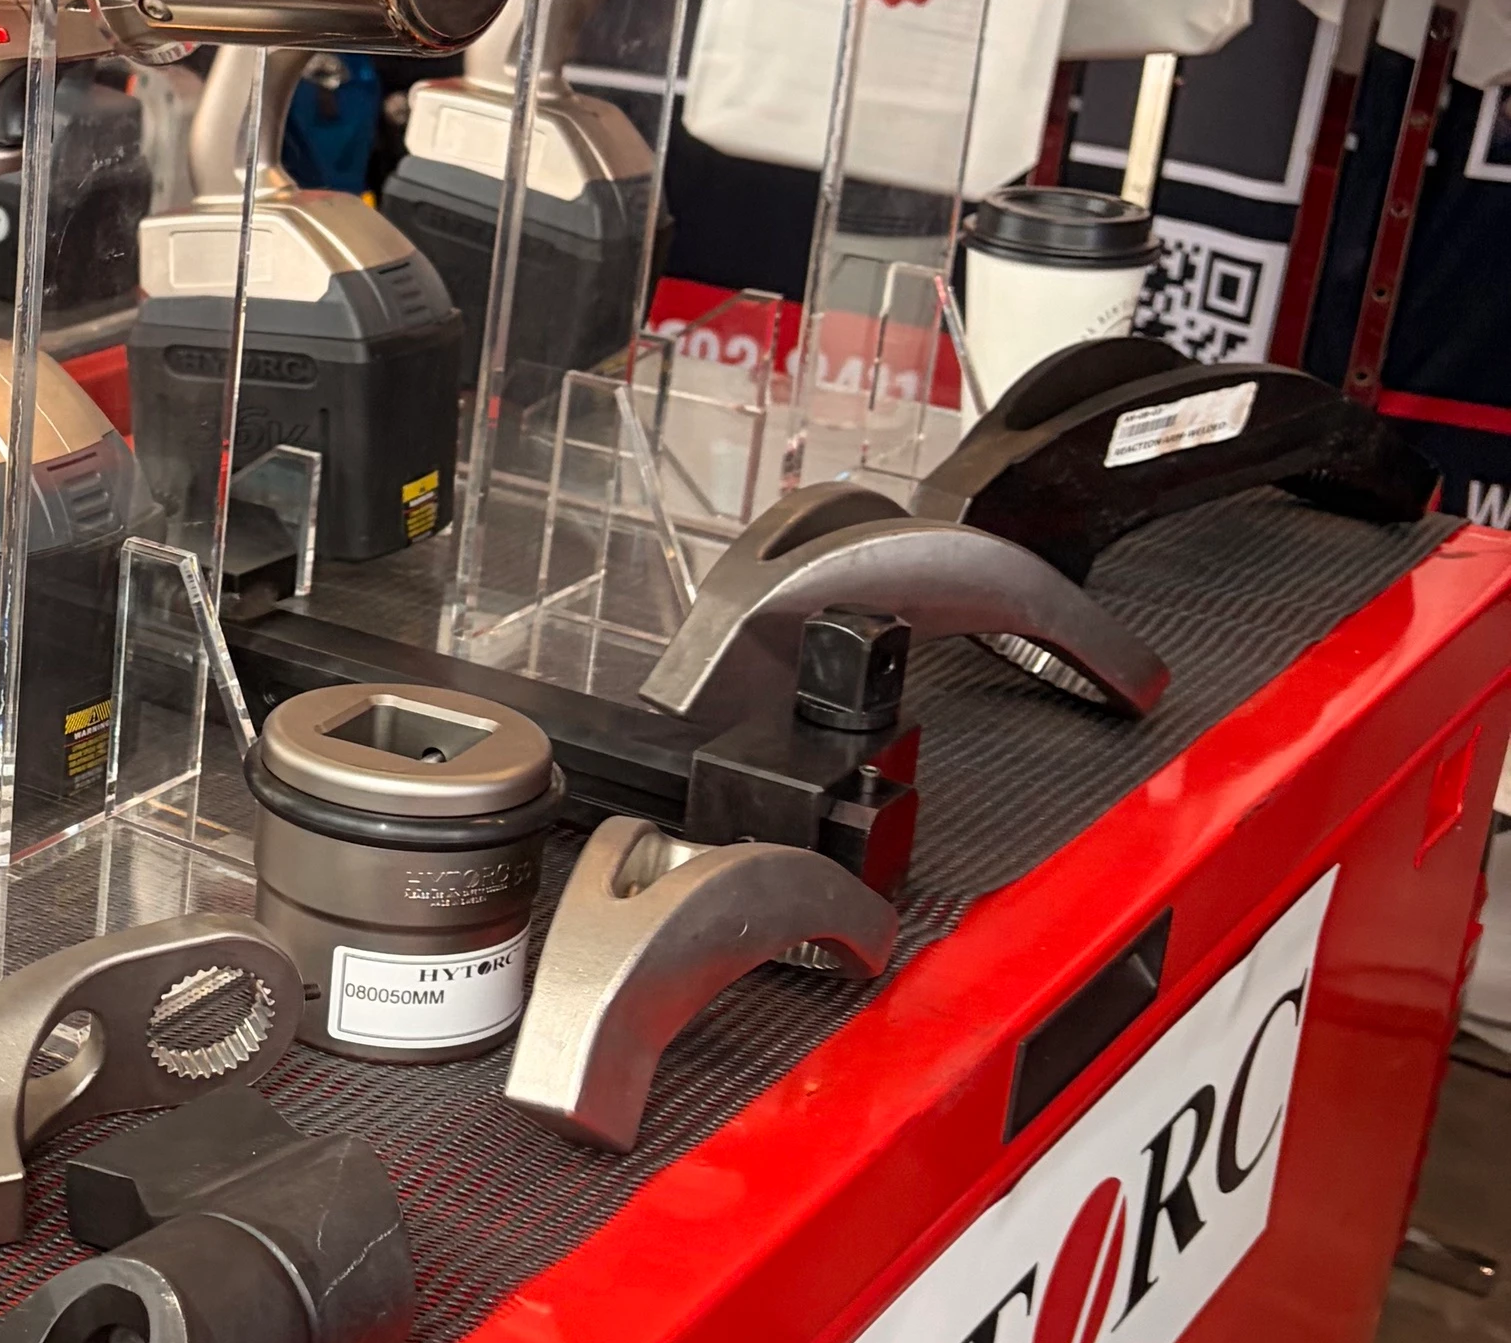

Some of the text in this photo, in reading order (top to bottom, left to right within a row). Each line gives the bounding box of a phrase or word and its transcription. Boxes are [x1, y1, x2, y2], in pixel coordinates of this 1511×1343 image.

[74, 720, 109, 740] WARNIN
[419, 946, 520, 982] HYTORC
[345, 983, 445, 1005] 080050MM
